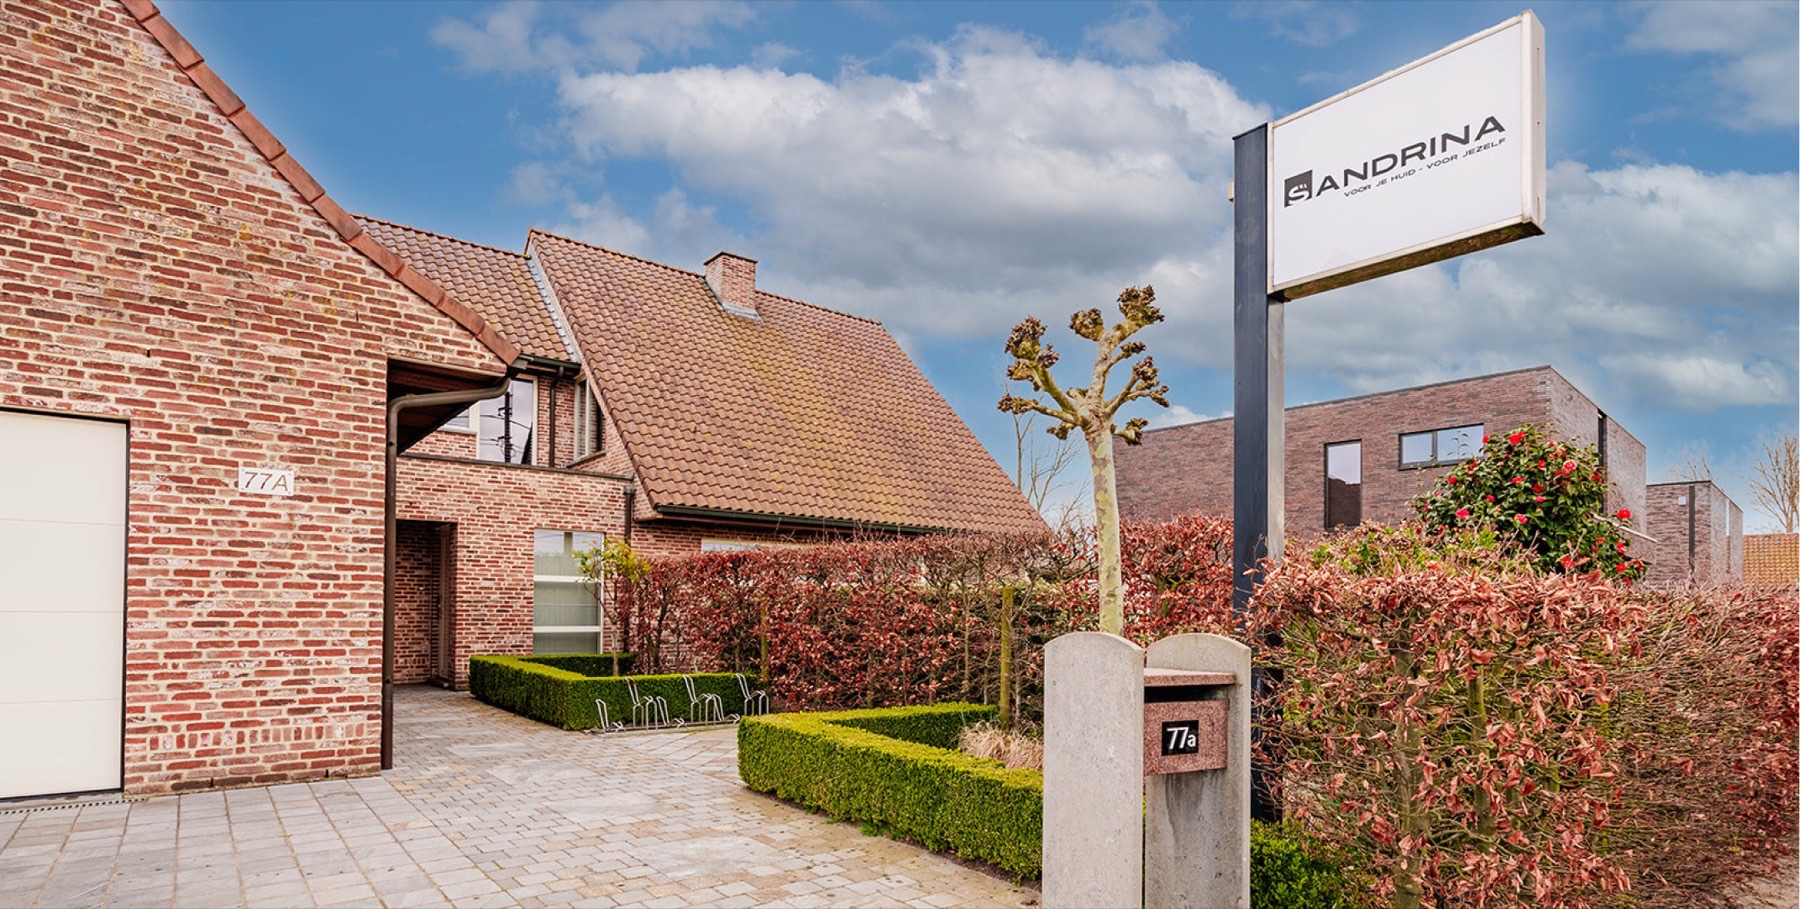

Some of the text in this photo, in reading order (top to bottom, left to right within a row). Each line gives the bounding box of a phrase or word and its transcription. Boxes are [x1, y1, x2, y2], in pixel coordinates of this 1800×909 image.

[1285, 116, 1506, 205] SANDRINA
[1343, 183, 1372, 198] VOOR
[1376, 178, 1388, 188] JE
[1390, 168, 1416, 182] HUID
[1426, 153, 1458, 170] VOOR
[1462, 137, 1507, 158] JEZELF
[245, 471, 289, 491] 77A
[1166, 726, 1197, 750] 77a
